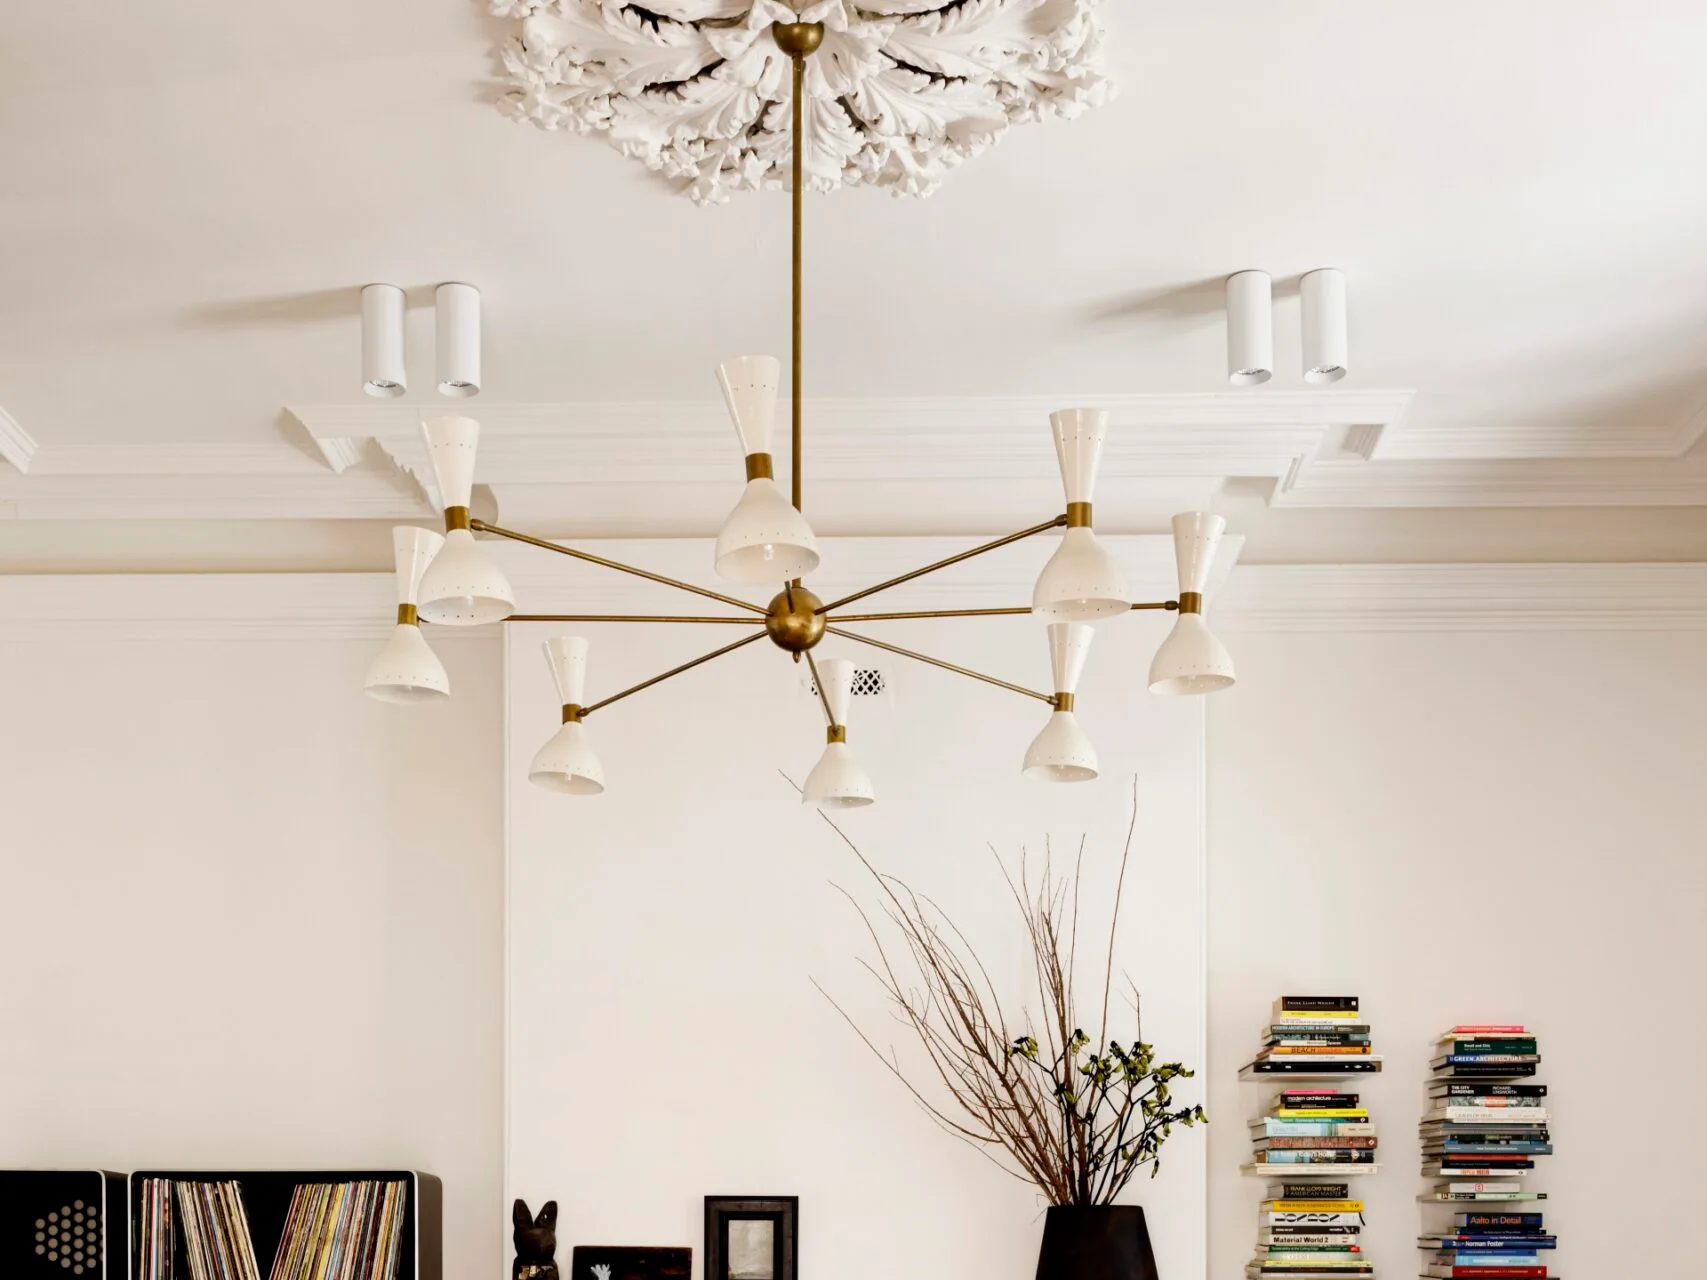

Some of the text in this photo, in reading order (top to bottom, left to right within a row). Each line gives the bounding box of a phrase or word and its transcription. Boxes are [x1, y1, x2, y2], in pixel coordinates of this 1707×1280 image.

[1471, 1216, 1521, 1224] Aalto in Detail
